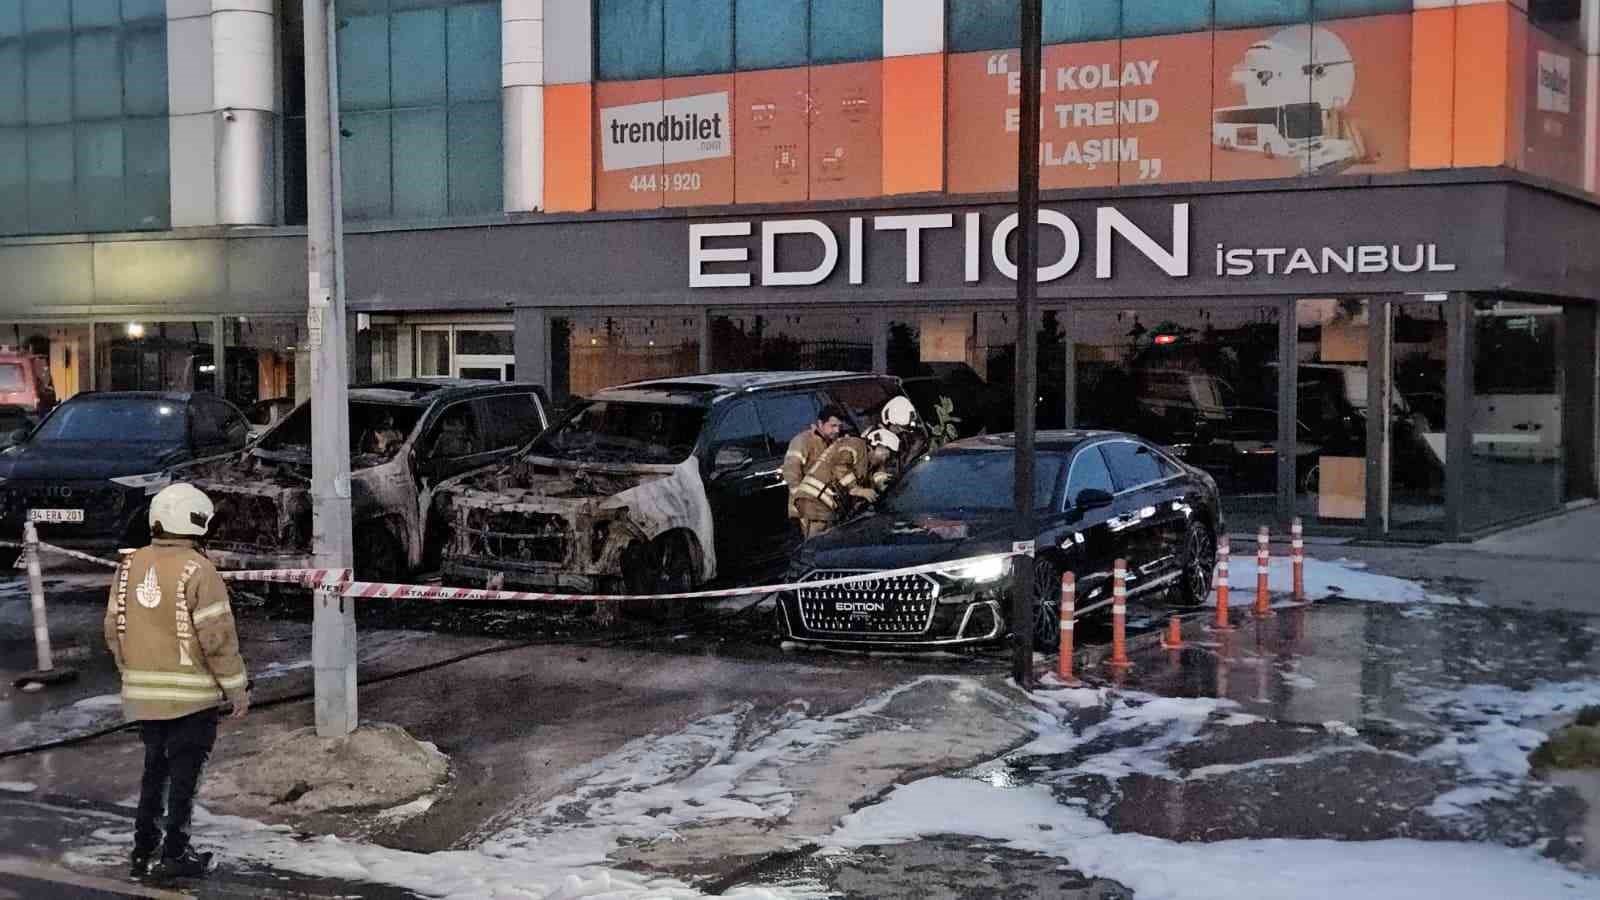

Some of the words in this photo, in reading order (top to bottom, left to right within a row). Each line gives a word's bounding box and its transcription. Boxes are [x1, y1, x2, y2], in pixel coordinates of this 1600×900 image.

[1055, 60, 1159, 91] KOLAY
[610, 112, 721, 144] trendbilet
[1005, 106, 1044, 132] E
[1055, 99, 1160, 128] TREND
[629, 174, 657, 192] 444
[673, 172, 701, 191] 920
[688, 203, 1190, 288] EDITION
[1216, 242, 1457, 276] İSTANBUL
[31, 510, 42, 520] 34
[66, 510, 82, 520] 201
[835, 602, 884, 611] EDITION
